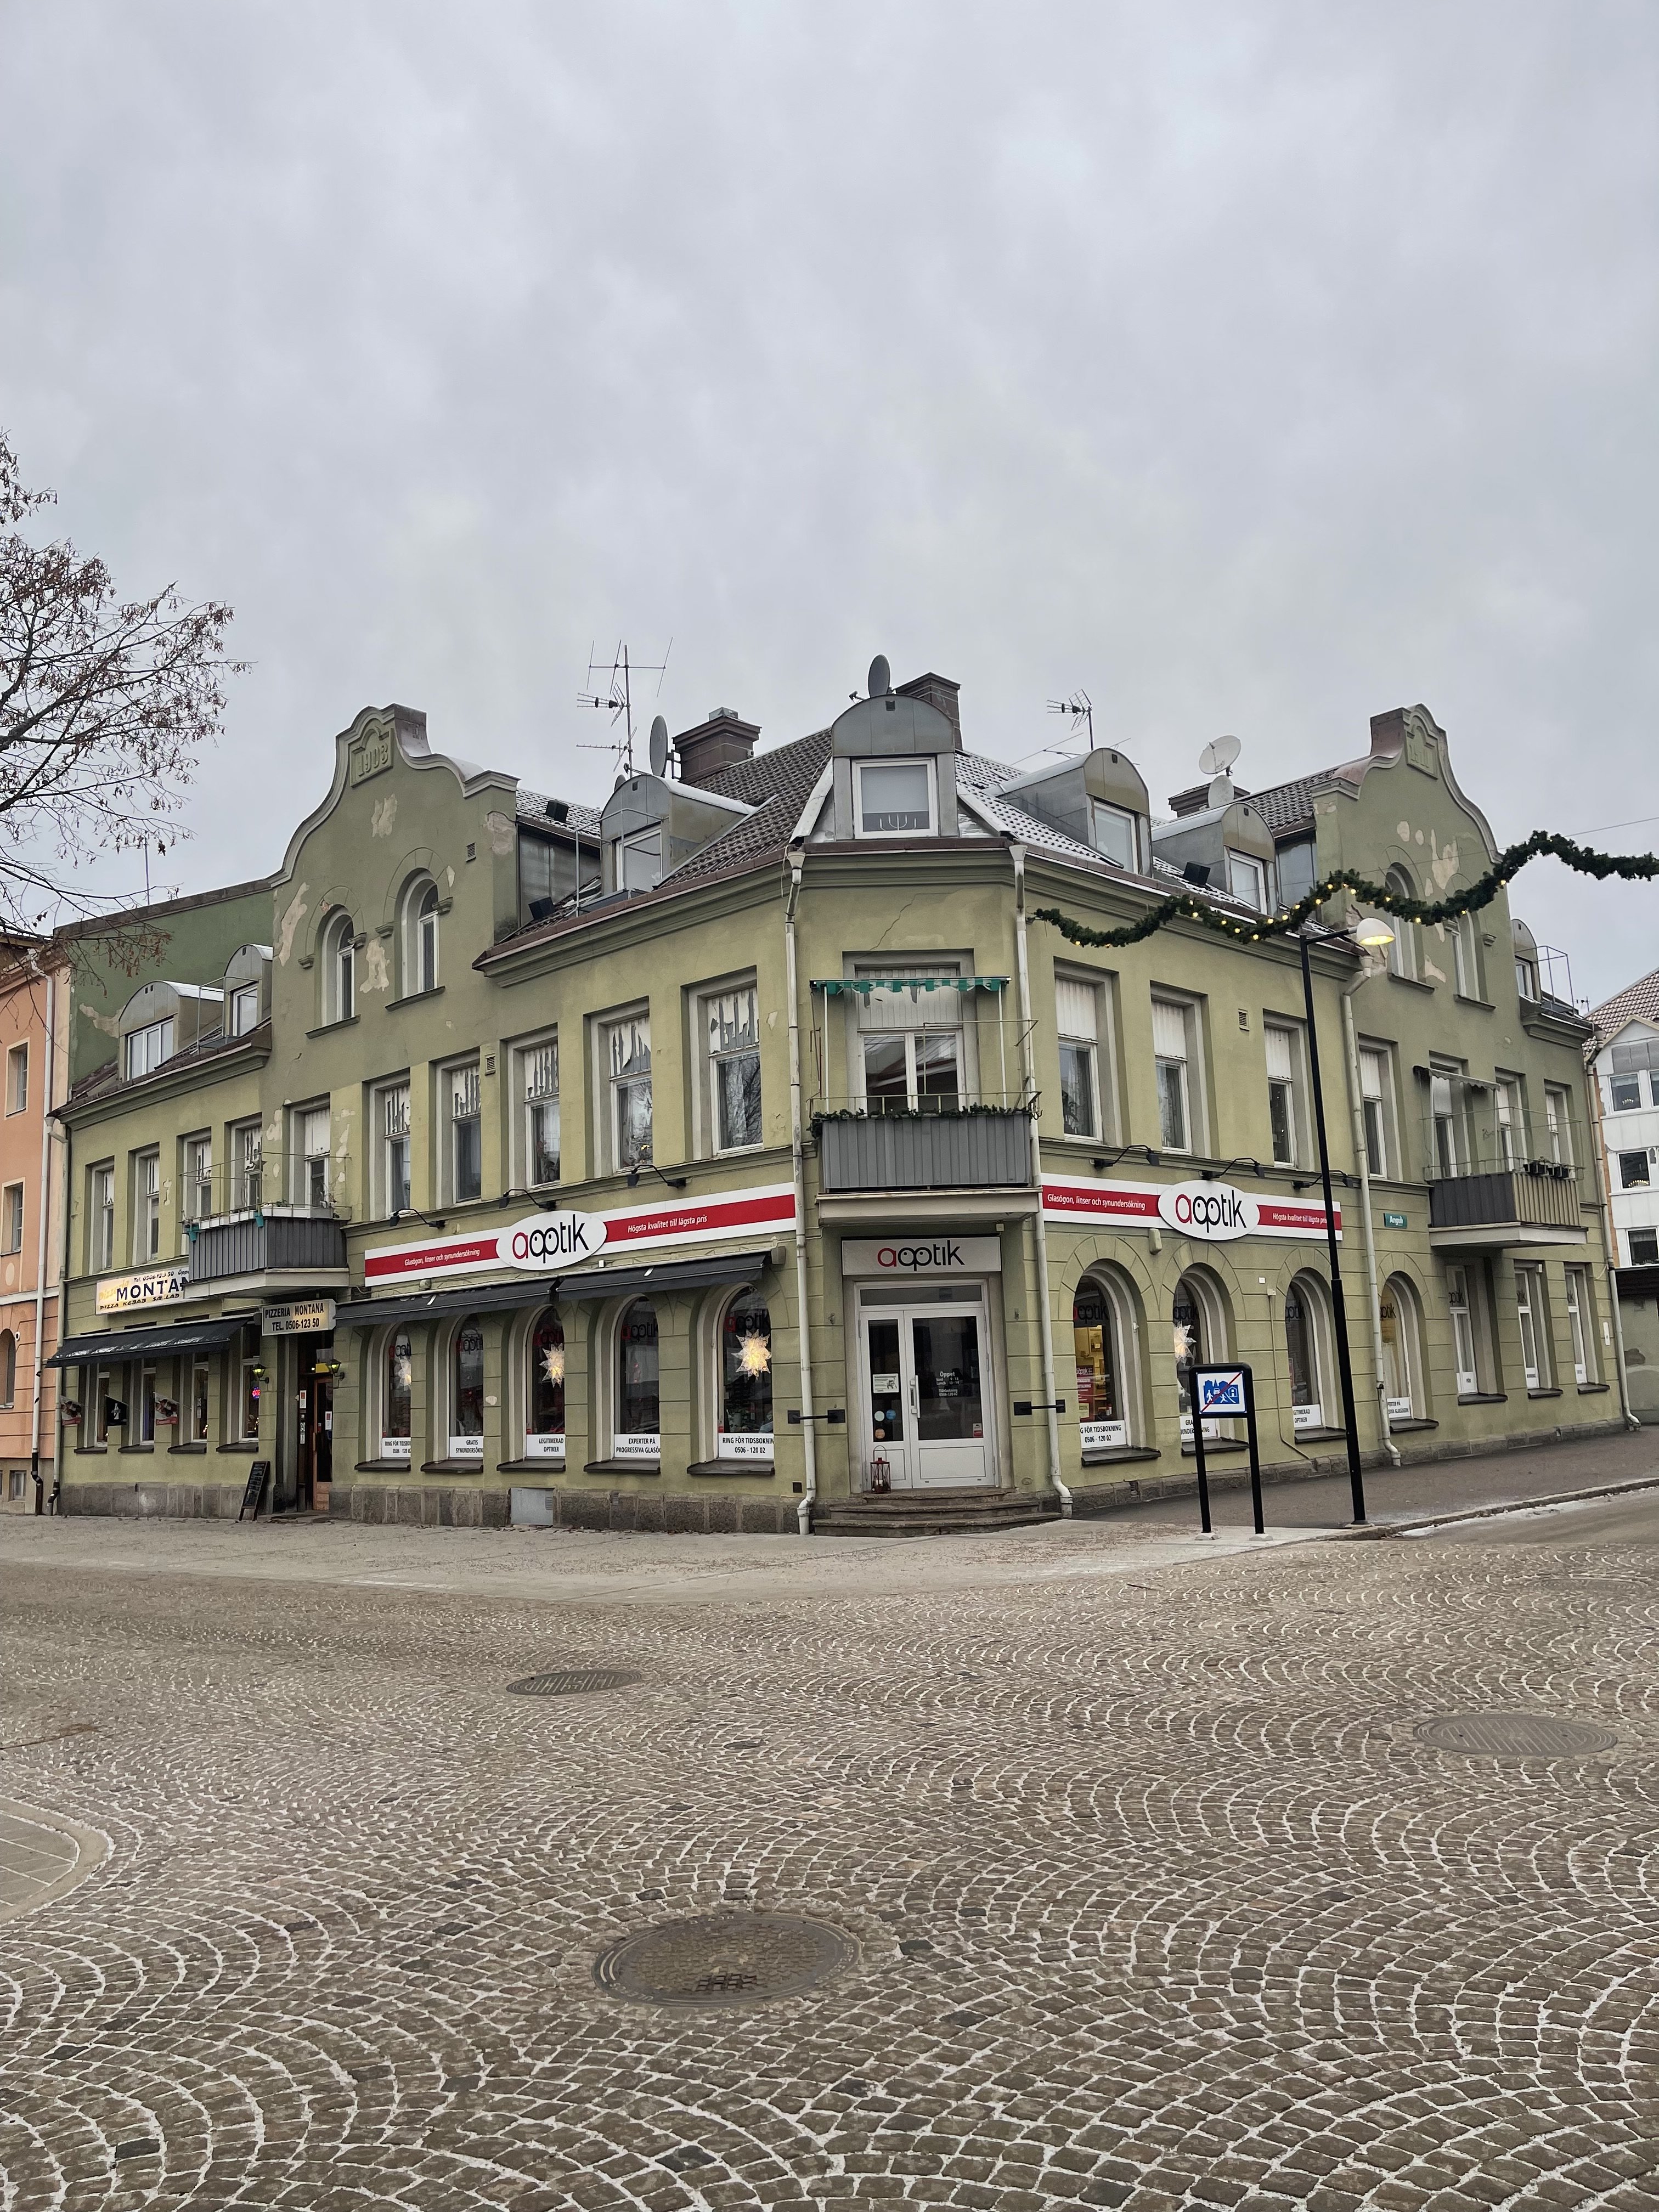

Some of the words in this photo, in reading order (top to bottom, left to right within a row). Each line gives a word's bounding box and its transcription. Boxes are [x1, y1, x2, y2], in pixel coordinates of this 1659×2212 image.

[1047, 1194, 1075, 1204] Glasögon,
[1076, 1196, 1091, 1204] linser
[1103, 1199, 1145, 1210] synundersökning
[628, 1224, 646, 1233] Högsta
[648, 1221, 668, 1229] kvalitet
[696, 1215, 707, 1224] pris
[1273, 1213, 1286, 1222] Högsta
[444, 1249, 480, 1261] synundersökning
[123, 1299, 146, 1307] KEBAB
[265, 1307, 290, 1318] PIZZERIA
[295, 1302, 324, 1316] MONTANA
[272, 1321, 284, 1331] TEL.
[286, 1318, 311, 1330] 0506-123
[312, 1317, 319, 1328] 50
[1085, 1425, 1093, 1434] FÖR
[1094, 1424, 1121, 1433] TIDSBOKNING
